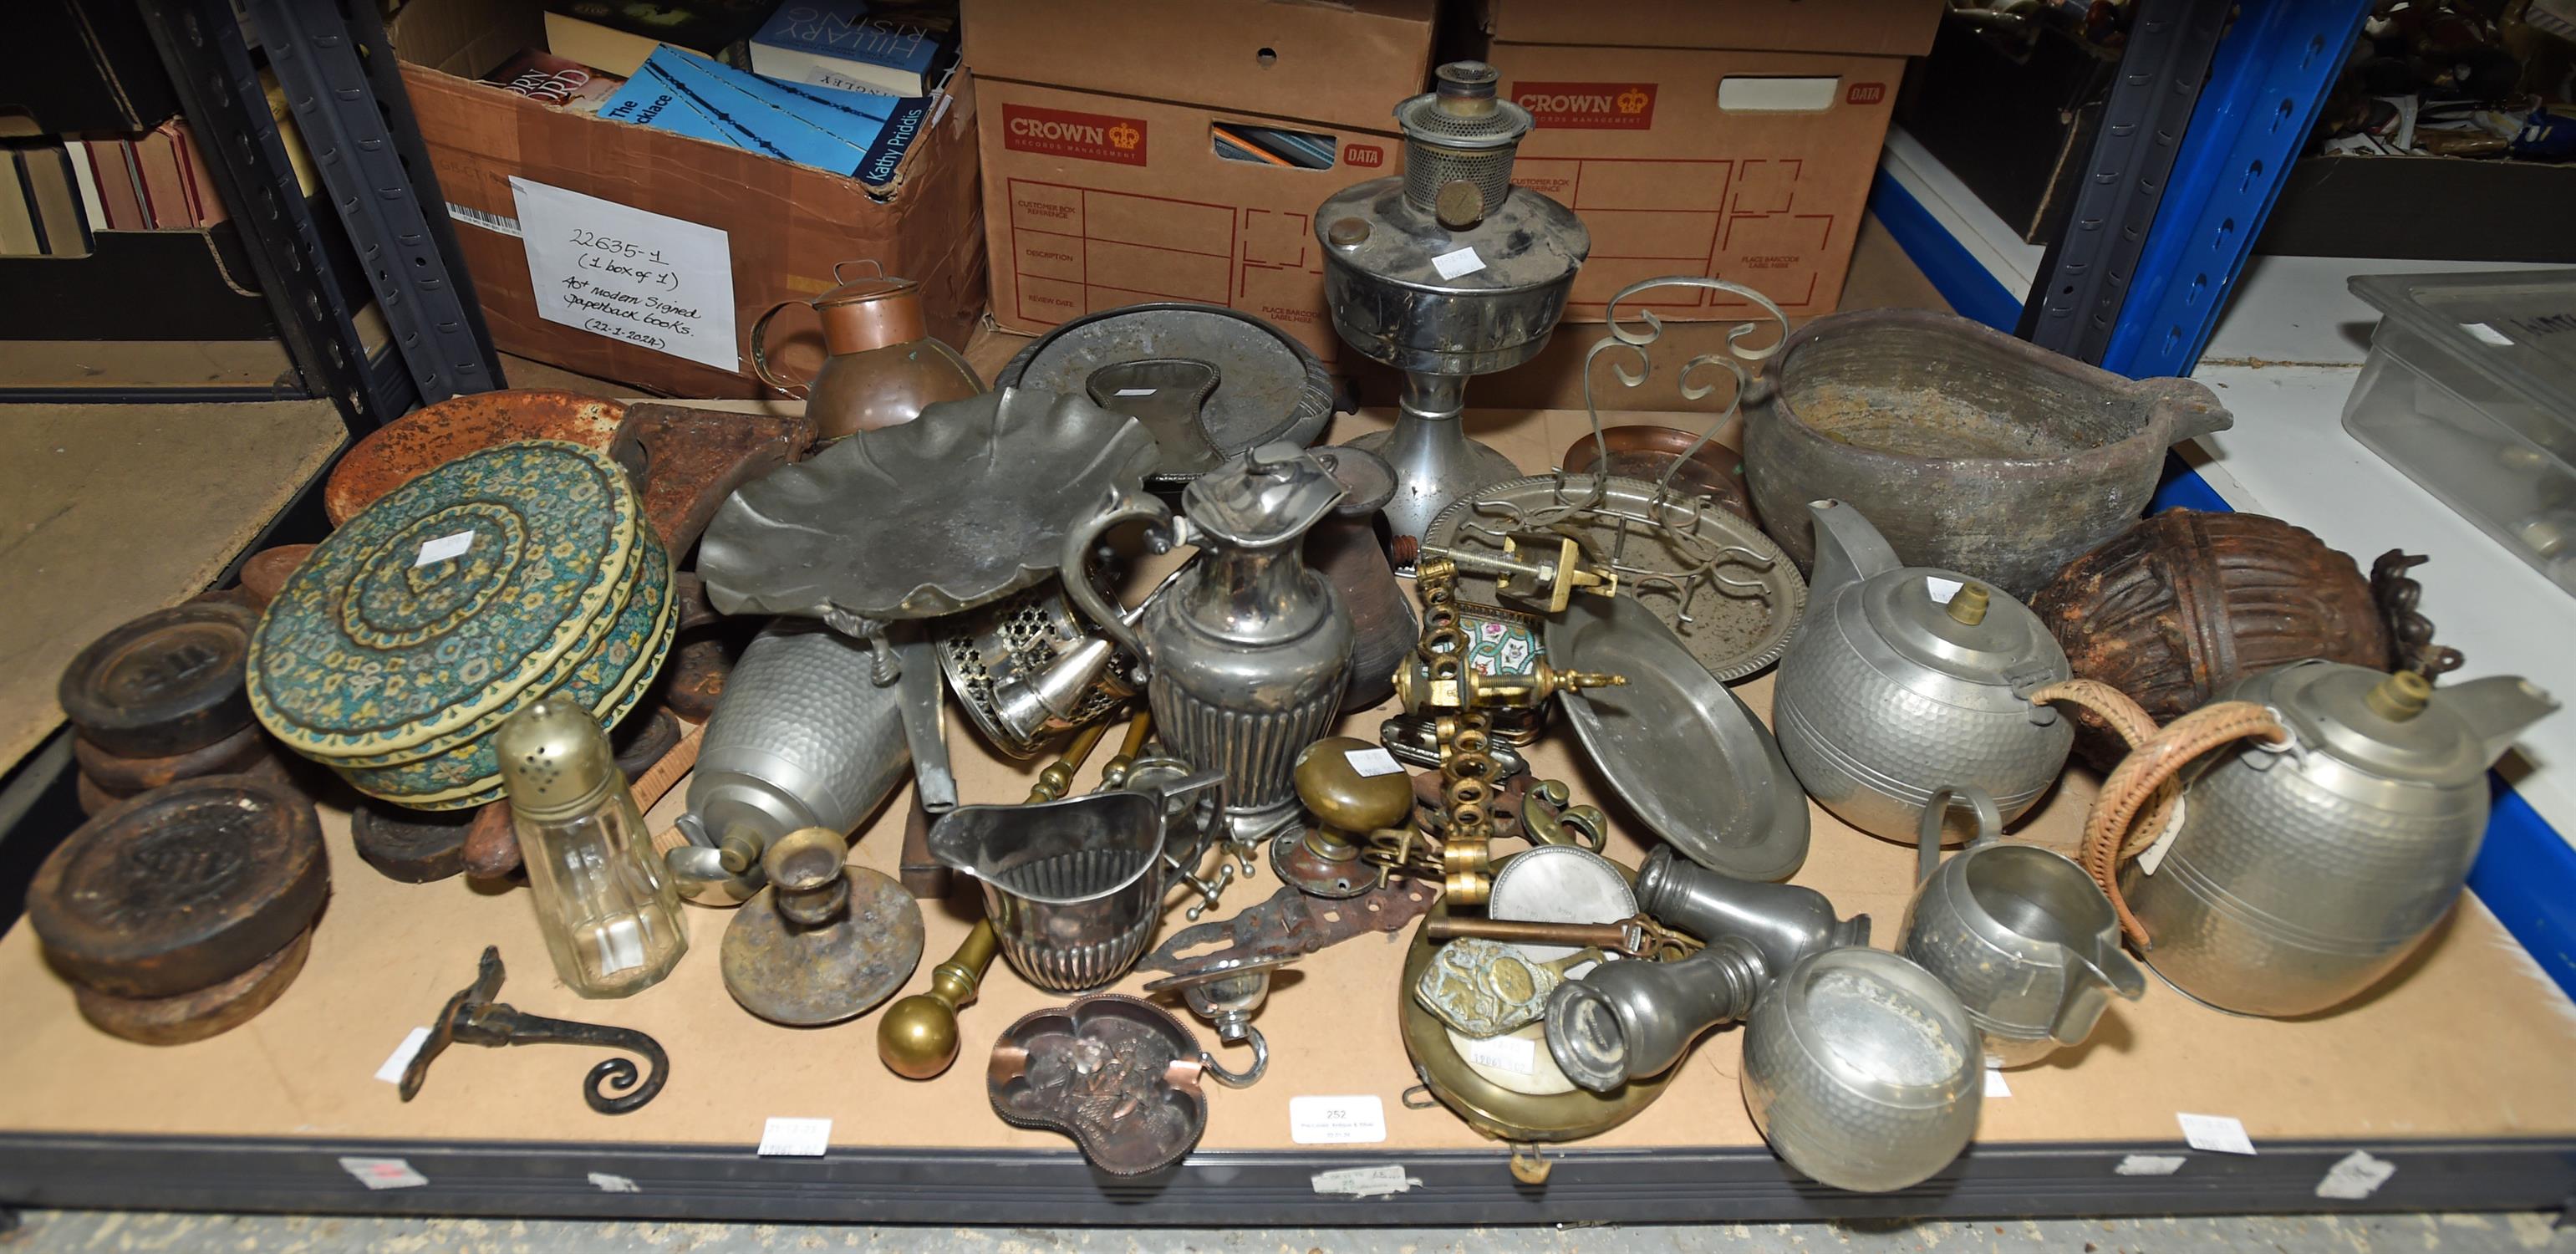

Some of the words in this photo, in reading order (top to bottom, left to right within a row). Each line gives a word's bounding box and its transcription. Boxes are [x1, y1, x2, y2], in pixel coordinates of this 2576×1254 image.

[787, 8, 928, 42] RISING
[776, 22, 918, 59] HILLARY
[1851, 87, 1880, 100] DATA
[608, 100, 638, 118] The
[634, 94, 673, 125] cklace
[1519, 94, 1613, 113] CROWN
[1011, 117, 1103, 145] CROWN
[866, 148, 904, 181] Kathy
[887, 109, 922, 145] Priddis
[1016, 139, 1061, 150] RECORDS
[1067, 145, 1136, 159] MANAGEMENT
[1348, 149, 1378, 163] DATA
[1018, 200, 1057, 211] CUSTOMER
[1059, 206, 1076, 214] BOX
[1027, 208, 1068, 219] REFERENCE
[570, 229, 669, 263] 22635-1
[1026, 249, 1074, 262] DESCRIPTION
[578, 253, 601, 269] (1
[606, 259, 633, 277] box
[636, 272, 652, 283] of
[656, 272, 679, 292] 1)
[1028, 294, 1055, 304] REVIEW
[1056, 299, 1074, 308] DATE
[1261, 306, 1285, 314] PLACE
[1326, 1109, 1347, 1119] 252
